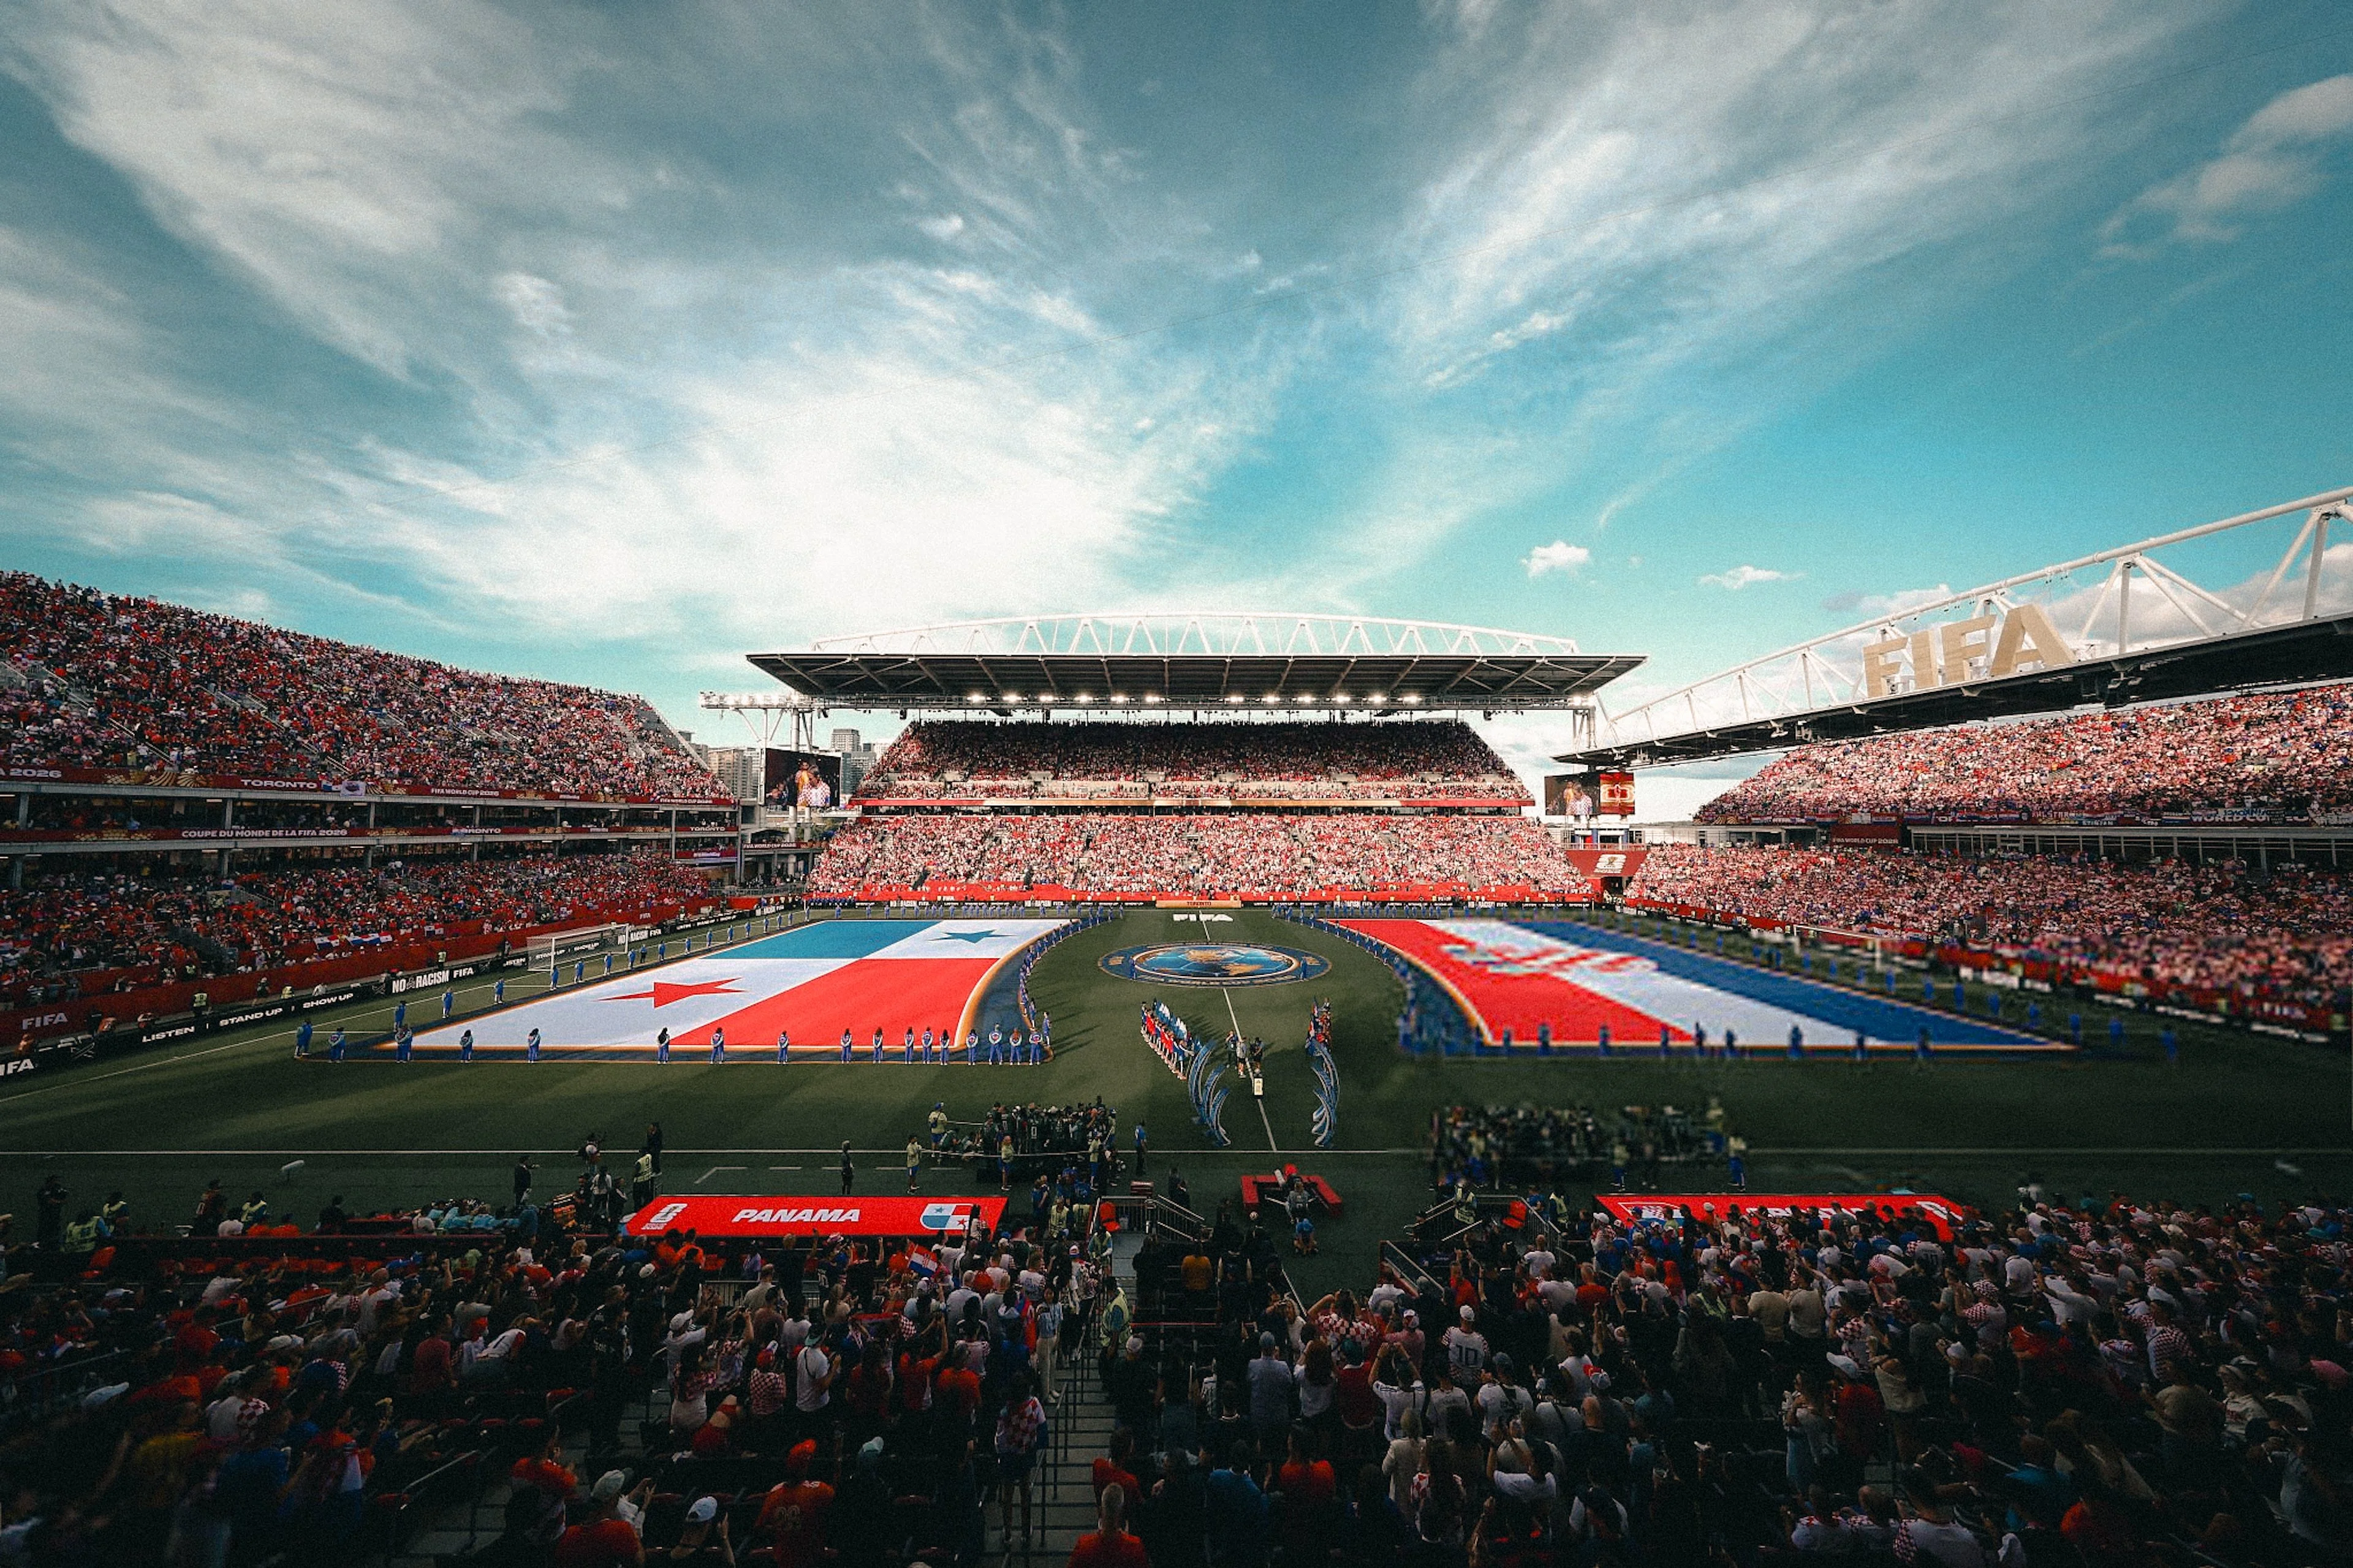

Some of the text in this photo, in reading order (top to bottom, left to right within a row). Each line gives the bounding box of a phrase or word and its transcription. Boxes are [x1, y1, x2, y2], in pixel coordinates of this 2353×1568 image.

[1863, 604, 2078, 698] FIFA
[10, 768, 62, 778] 2026
[241, 779, 317, 789] TORONTO
[392, 967, 474, 994] NO RACISM FIFA
[21, 1012, 69, 1031] FIFA
[142, 993, 354, 1043] LISTEN STAND UP SHOW UP
[732, 1209, 861, 1223] PANAMA
[1455, 1344, 1479, 1367] 10
